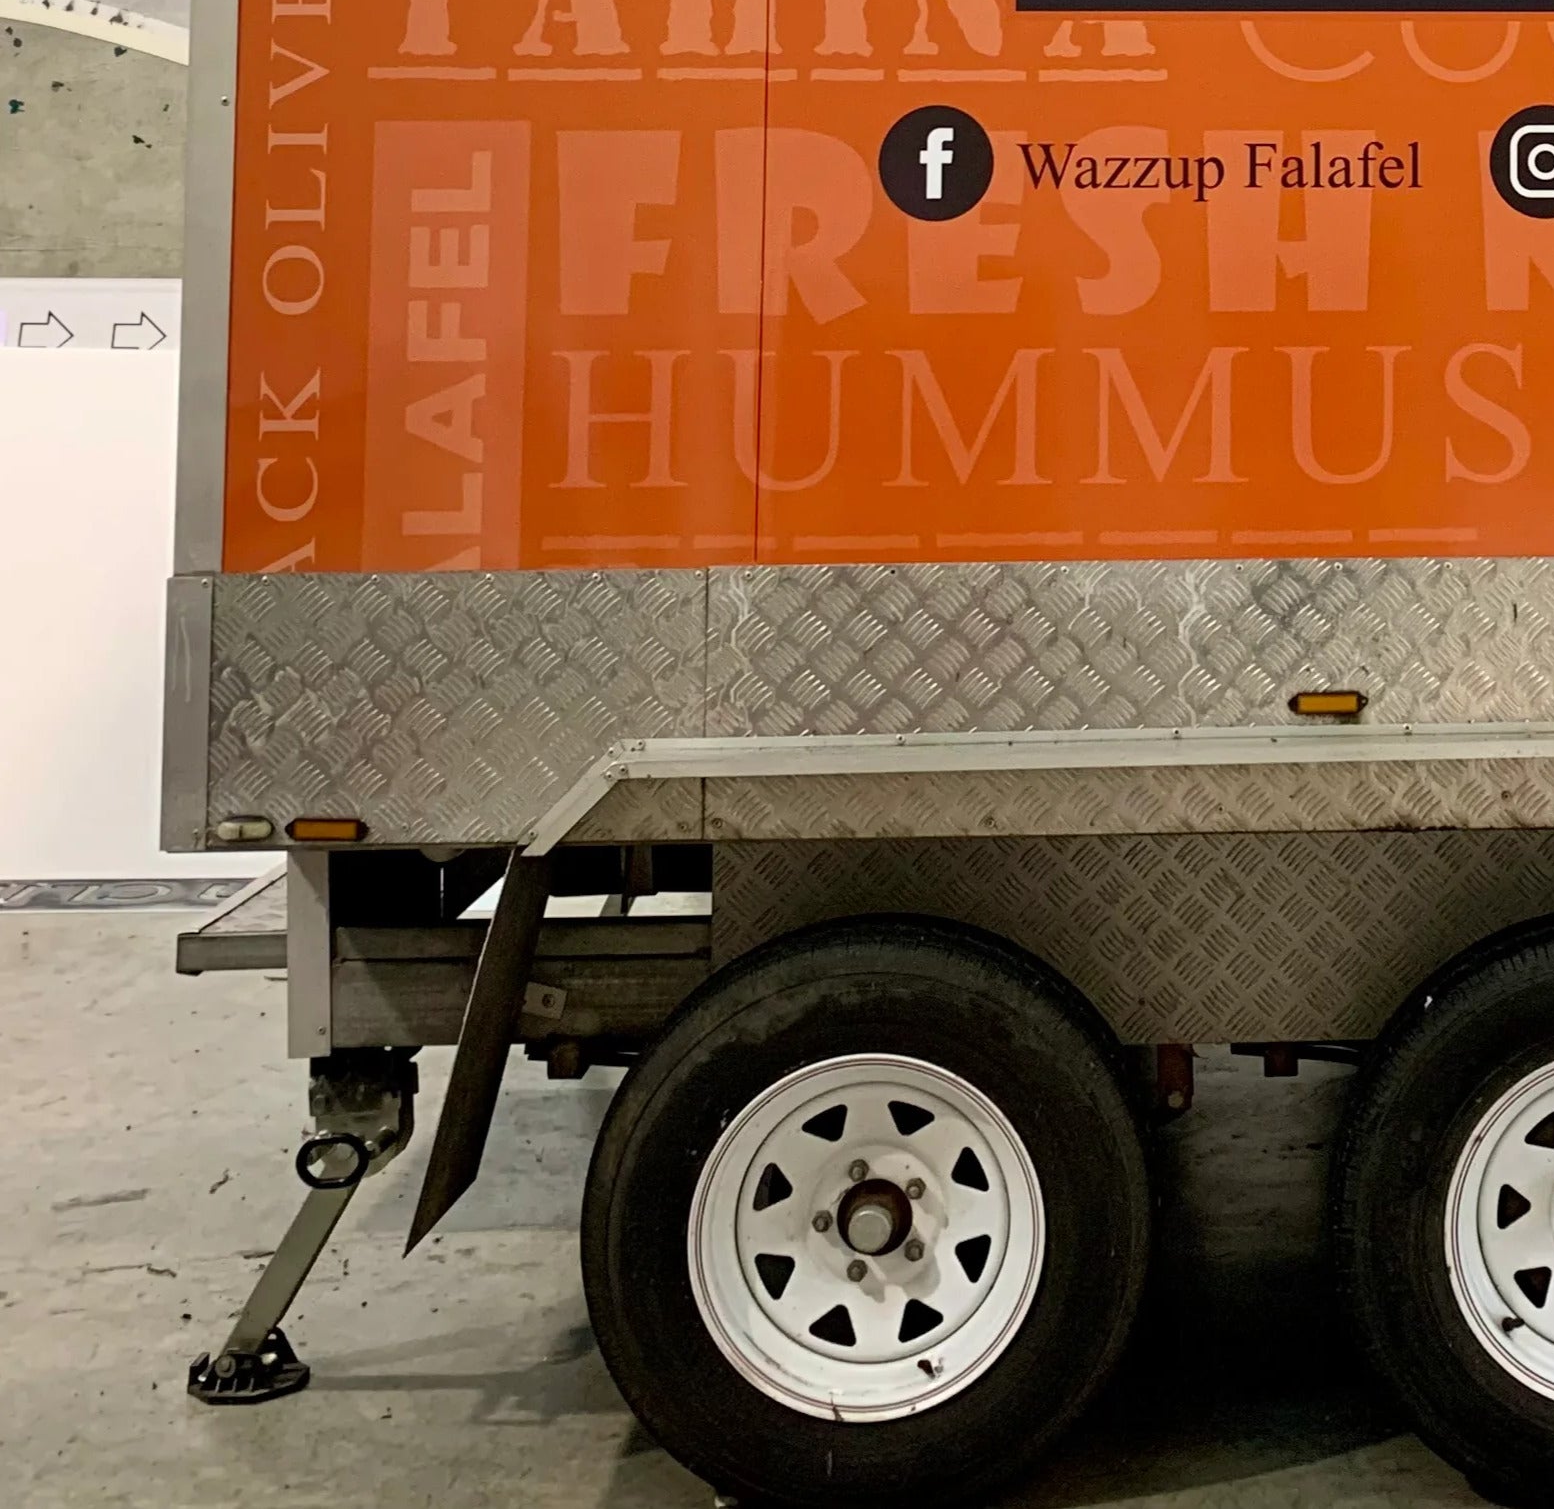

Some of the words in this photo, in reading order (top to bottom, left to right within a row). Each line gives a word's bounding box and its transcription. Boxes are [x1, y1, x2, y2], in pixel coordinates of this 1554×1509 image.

[556, 126, 1375, 324] FRESH
[1018, 142, 1226, 202] Wazzup
[1243, 141, 1424, 191] Falafel
[549, 342, 1531, 491] HUMMUS
